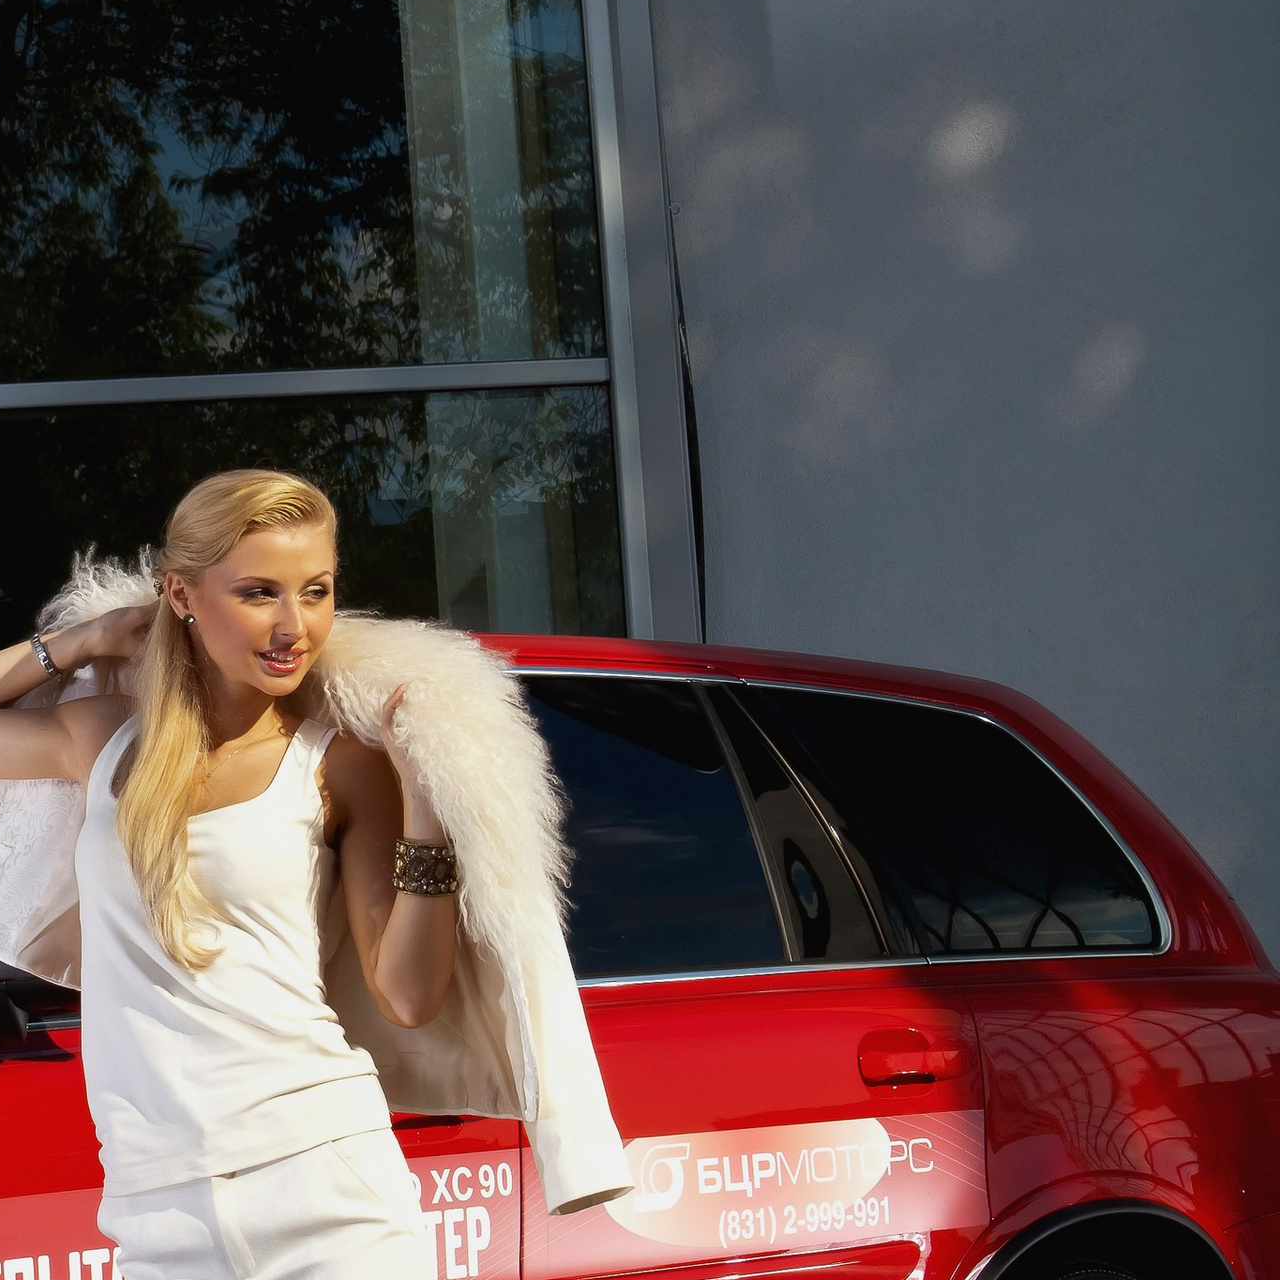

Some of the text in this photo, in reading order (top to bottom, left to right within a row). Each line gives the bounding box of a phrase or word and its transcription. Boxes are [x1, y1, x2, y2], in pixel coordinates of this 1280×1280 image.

[430, 1166, 474, 1205] XC
[478, 1162, 513, 1199] 90
[696, 1138, 934, 1198] БЦРМОТОРС
[718, 1195, 890, 1249] (831) 2-999-991
